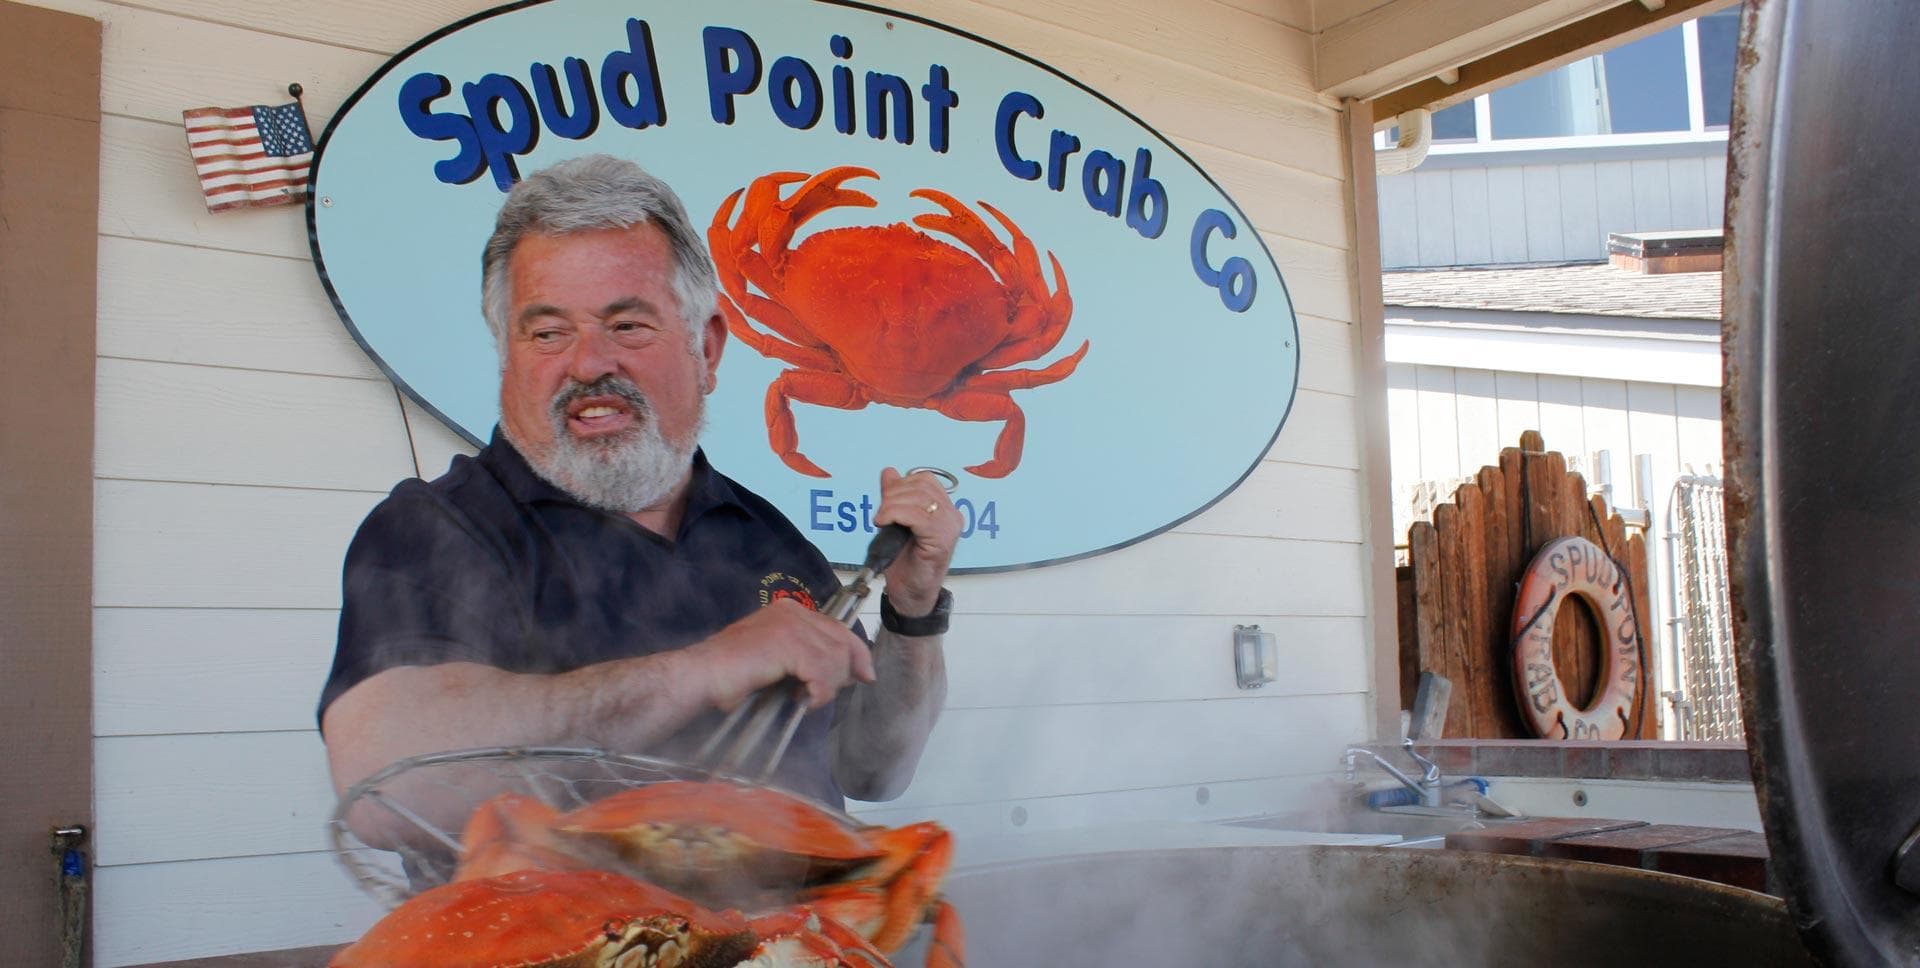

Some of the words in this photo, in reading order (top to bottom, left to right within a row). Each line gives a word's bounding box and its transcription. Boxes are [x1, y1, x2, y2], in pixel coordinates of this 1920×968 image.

[398, 17, 667, 193] Spud
[703, 26, 959, 153] Point
[995, 91, 1168, 239] Crab
[1190, 208, 1257, 312] Co
[954, 498, 1000, 539] 04
[1550, 543, 1614, 590] SPUD
